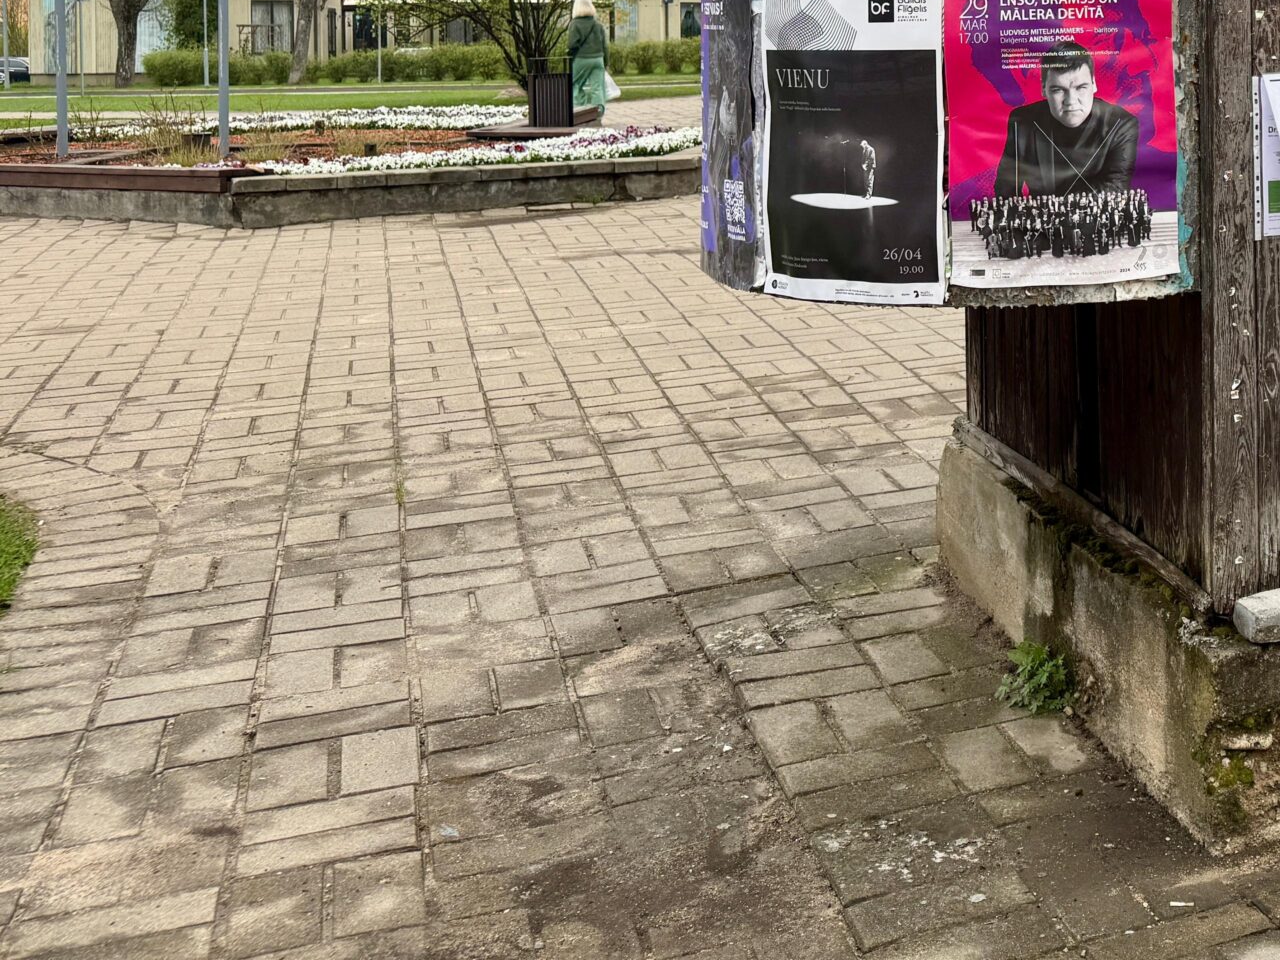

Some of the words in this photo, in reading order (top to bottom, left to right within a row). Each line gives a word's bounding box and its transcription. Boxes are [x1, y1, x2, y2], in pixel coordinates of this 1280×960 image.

[1000, 7, 1054, 21] MĀLERA
[1058, 5, 1104, 19] DEVĪTĀ
[959, 19, 987, 30] MAR
[959, 32, 988, 44] 17.00
[776, 69, 830, 88] VIENU
[883, 248, 922, 262] 26/04
[900, 265, 924, 273] 19.00
